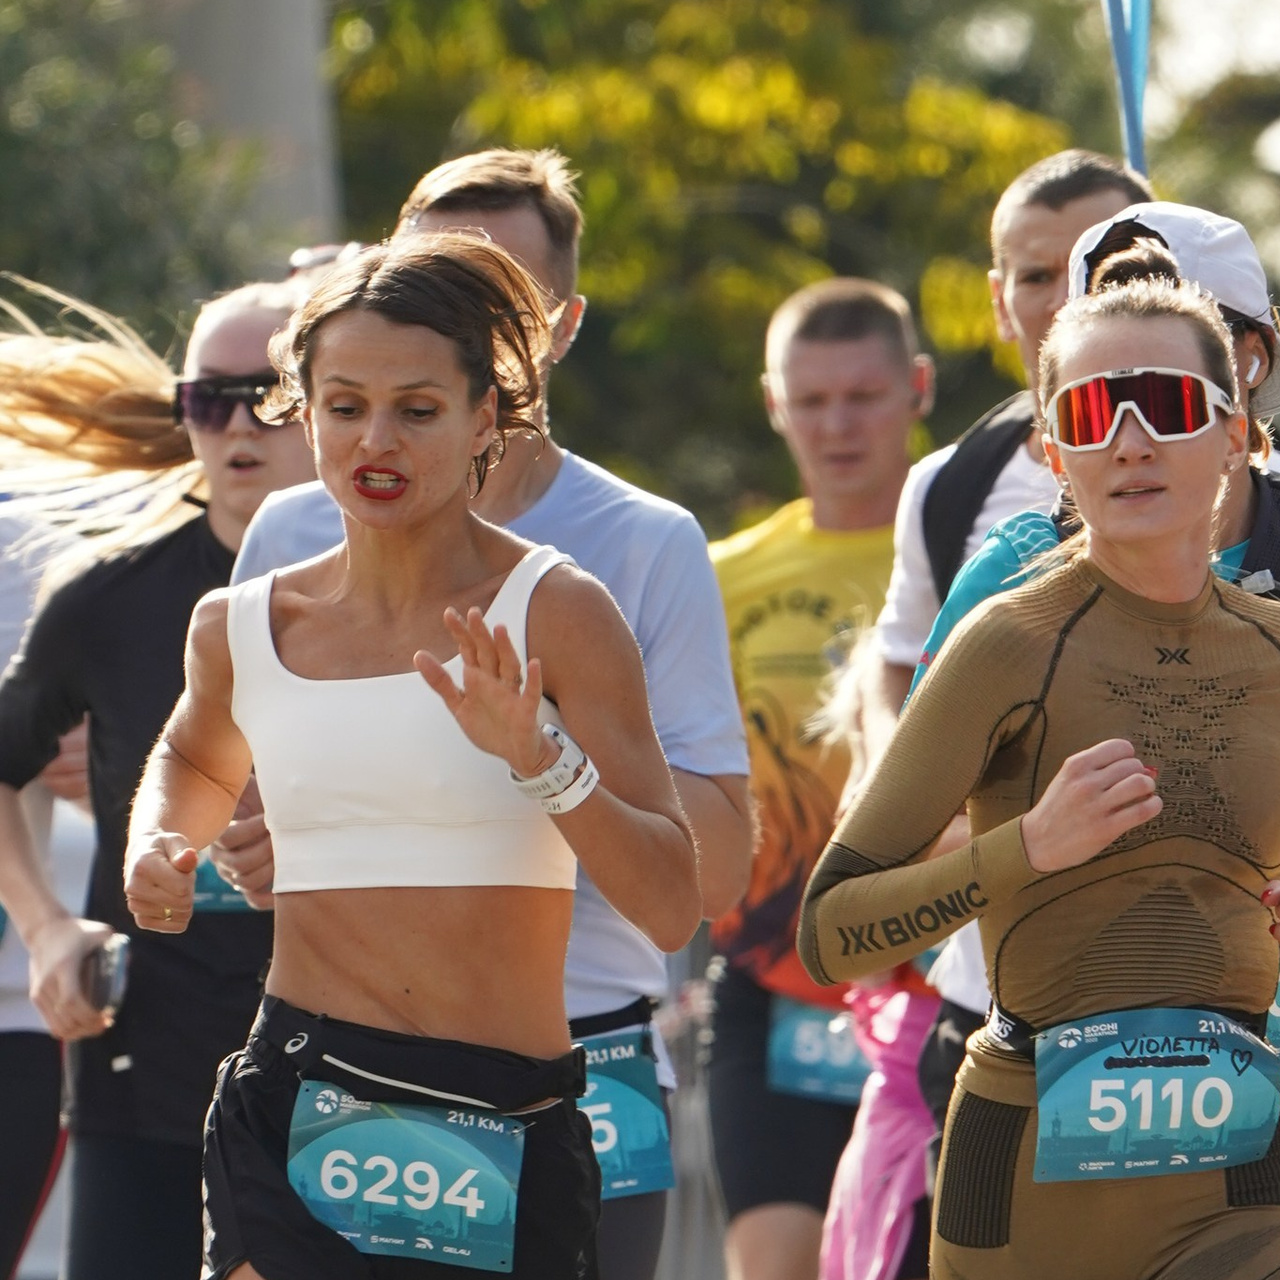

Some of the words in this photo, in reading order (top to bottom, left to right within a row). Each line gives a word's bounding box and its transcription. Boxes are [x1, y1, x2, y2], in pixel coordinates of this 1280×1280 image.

[1084, 1022, 1118, 1034] SOCHI
[1198, 1020, 1226, 1035] 21,1
[1088, 1077, 1234, 1132] 5110
[447, 1110, 475, 1127] 21,1
[477, 1117, 504, 1134] KM
[320, 1149, 486, 1218] 6294
